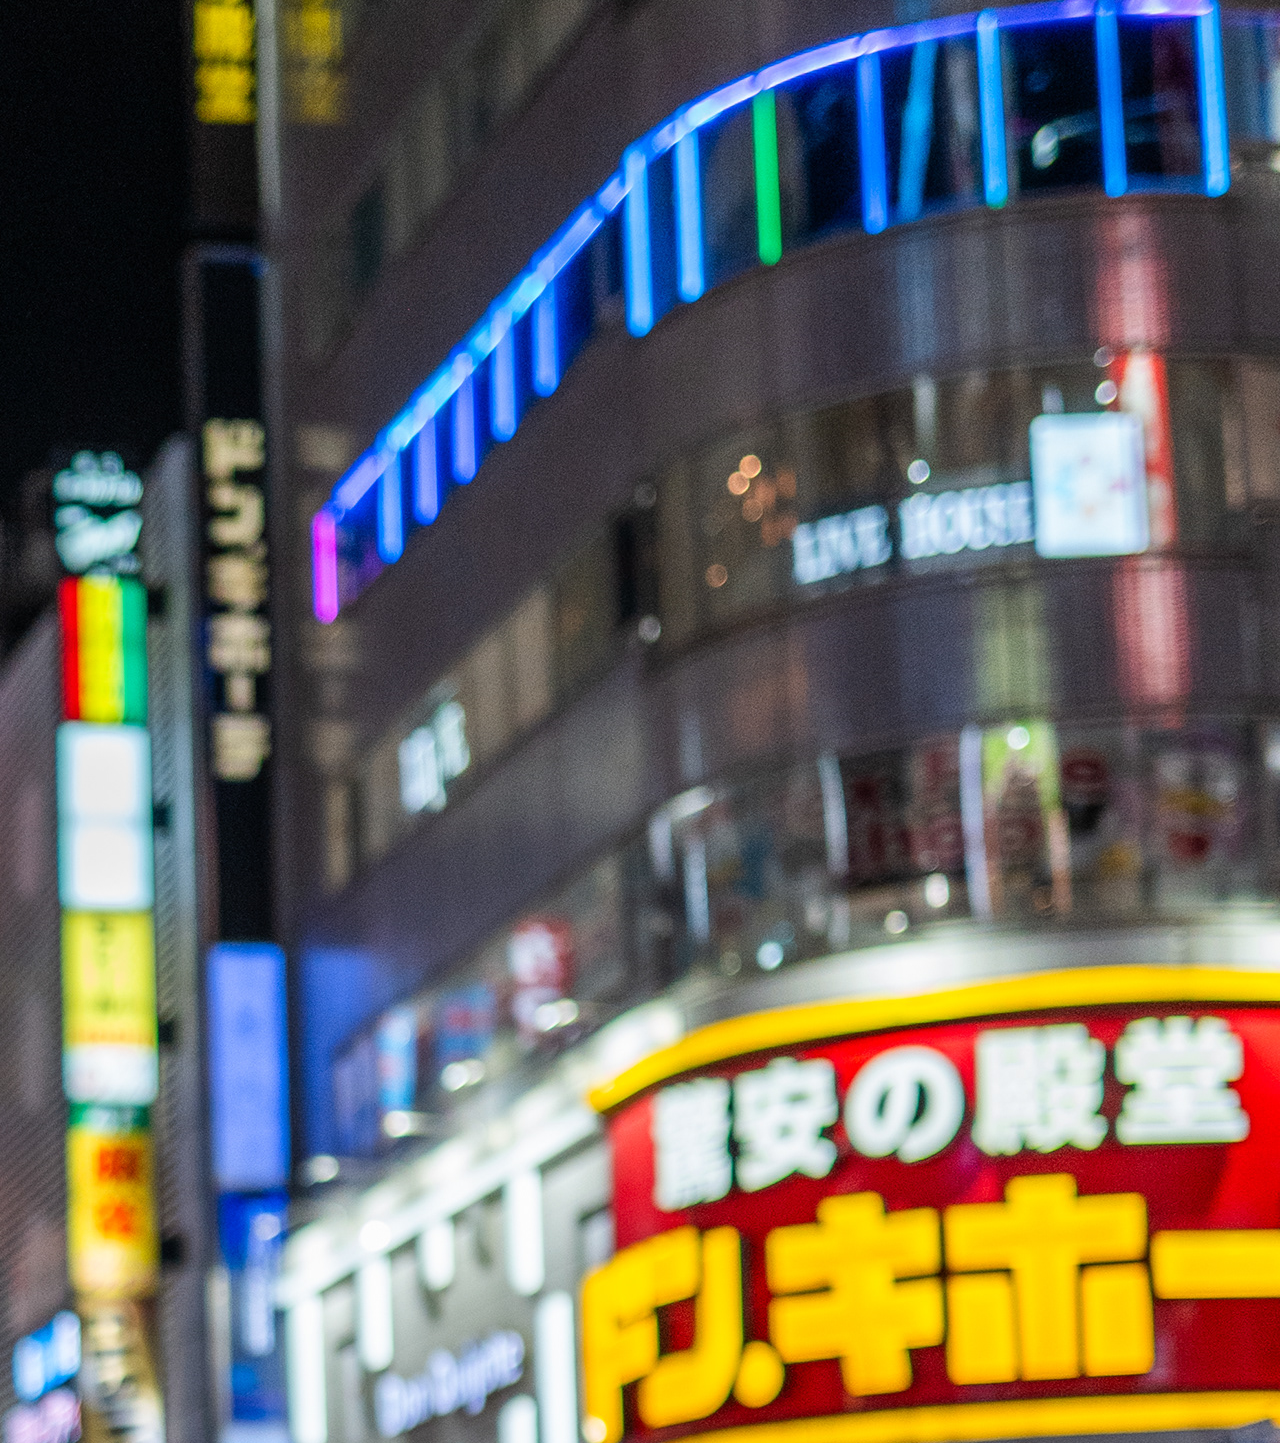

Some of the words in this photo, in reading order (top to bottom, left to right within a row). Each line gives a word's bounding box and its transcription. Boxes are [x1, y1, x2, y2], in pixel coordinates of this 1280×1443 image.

[792, 504, 893, 584] LIVE
[653, 1018, 1248, 1210] 驚安の殿堂
